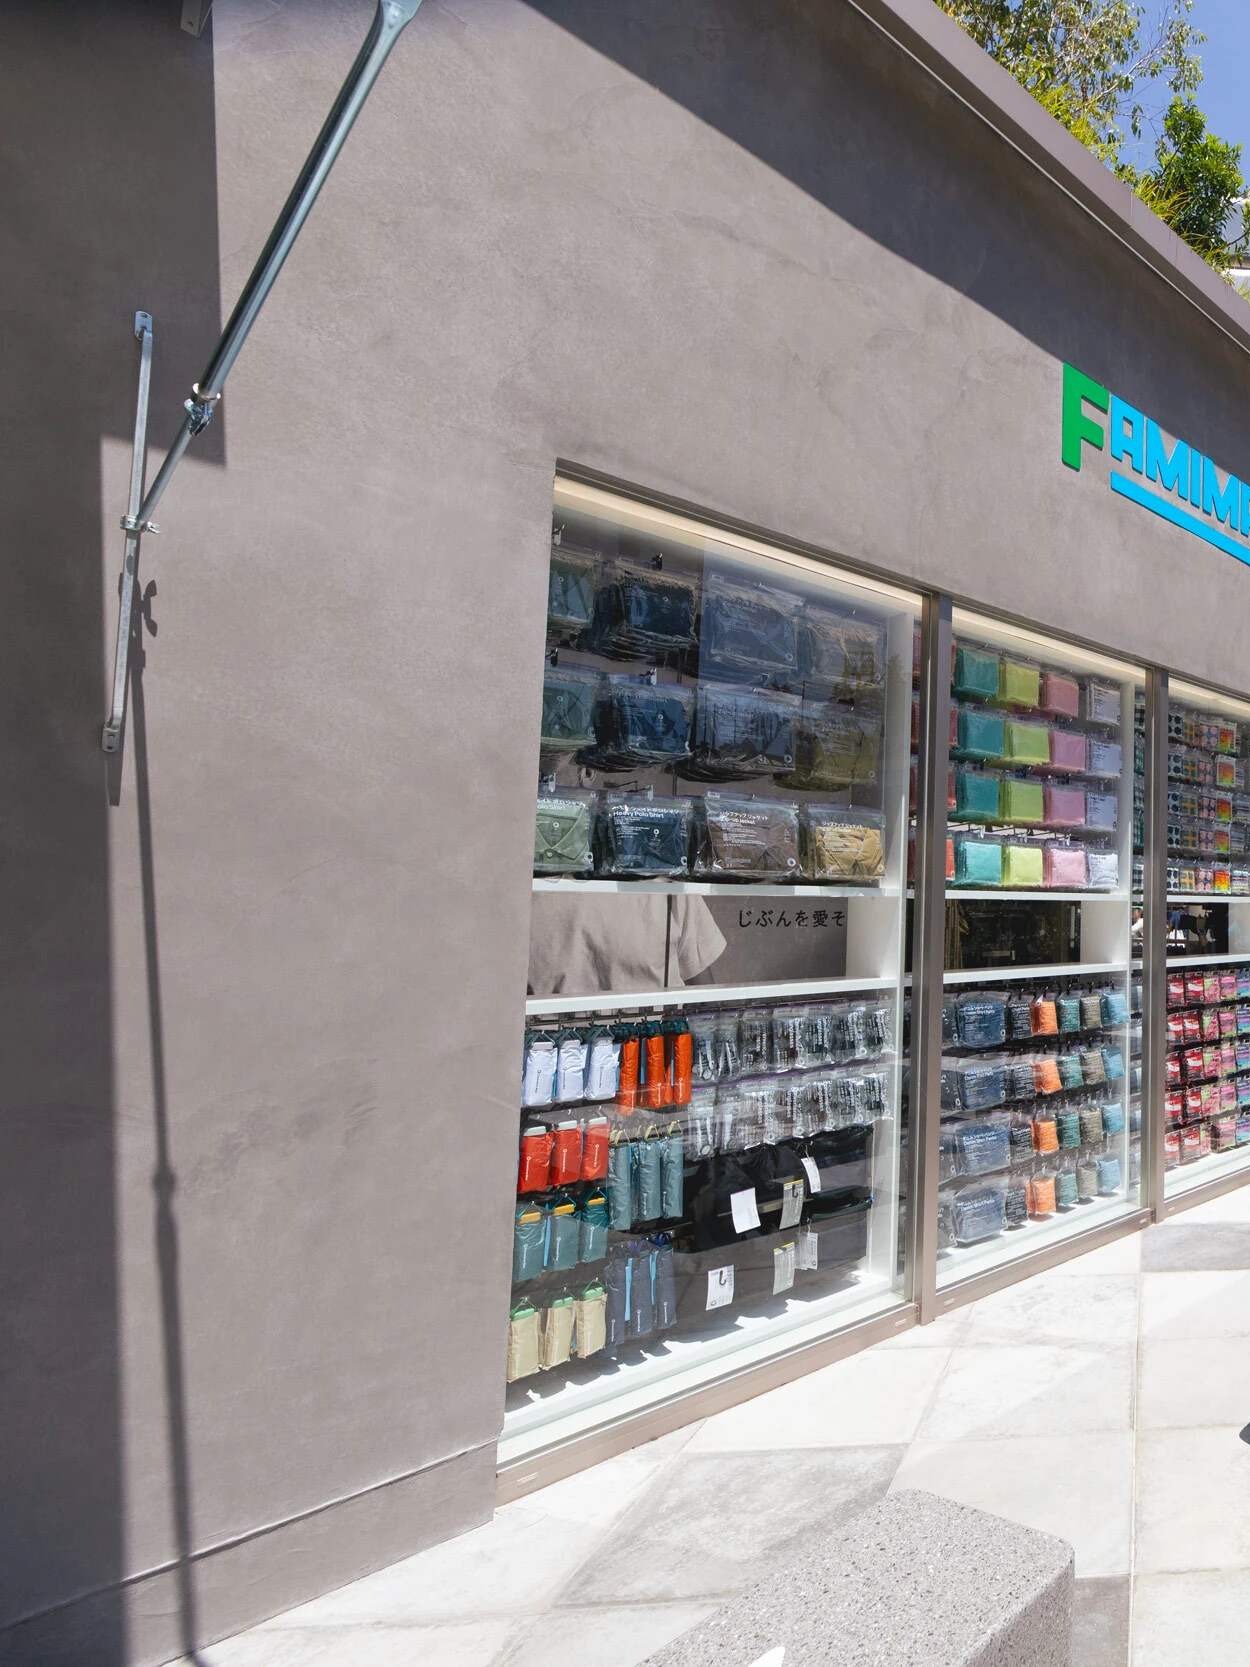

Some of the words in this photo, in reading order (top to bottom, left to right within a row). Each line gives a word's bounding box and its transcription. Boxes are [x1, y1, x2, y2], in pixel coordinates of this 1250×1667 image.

[739, 909, 845, 928] じぶんを愛そ
